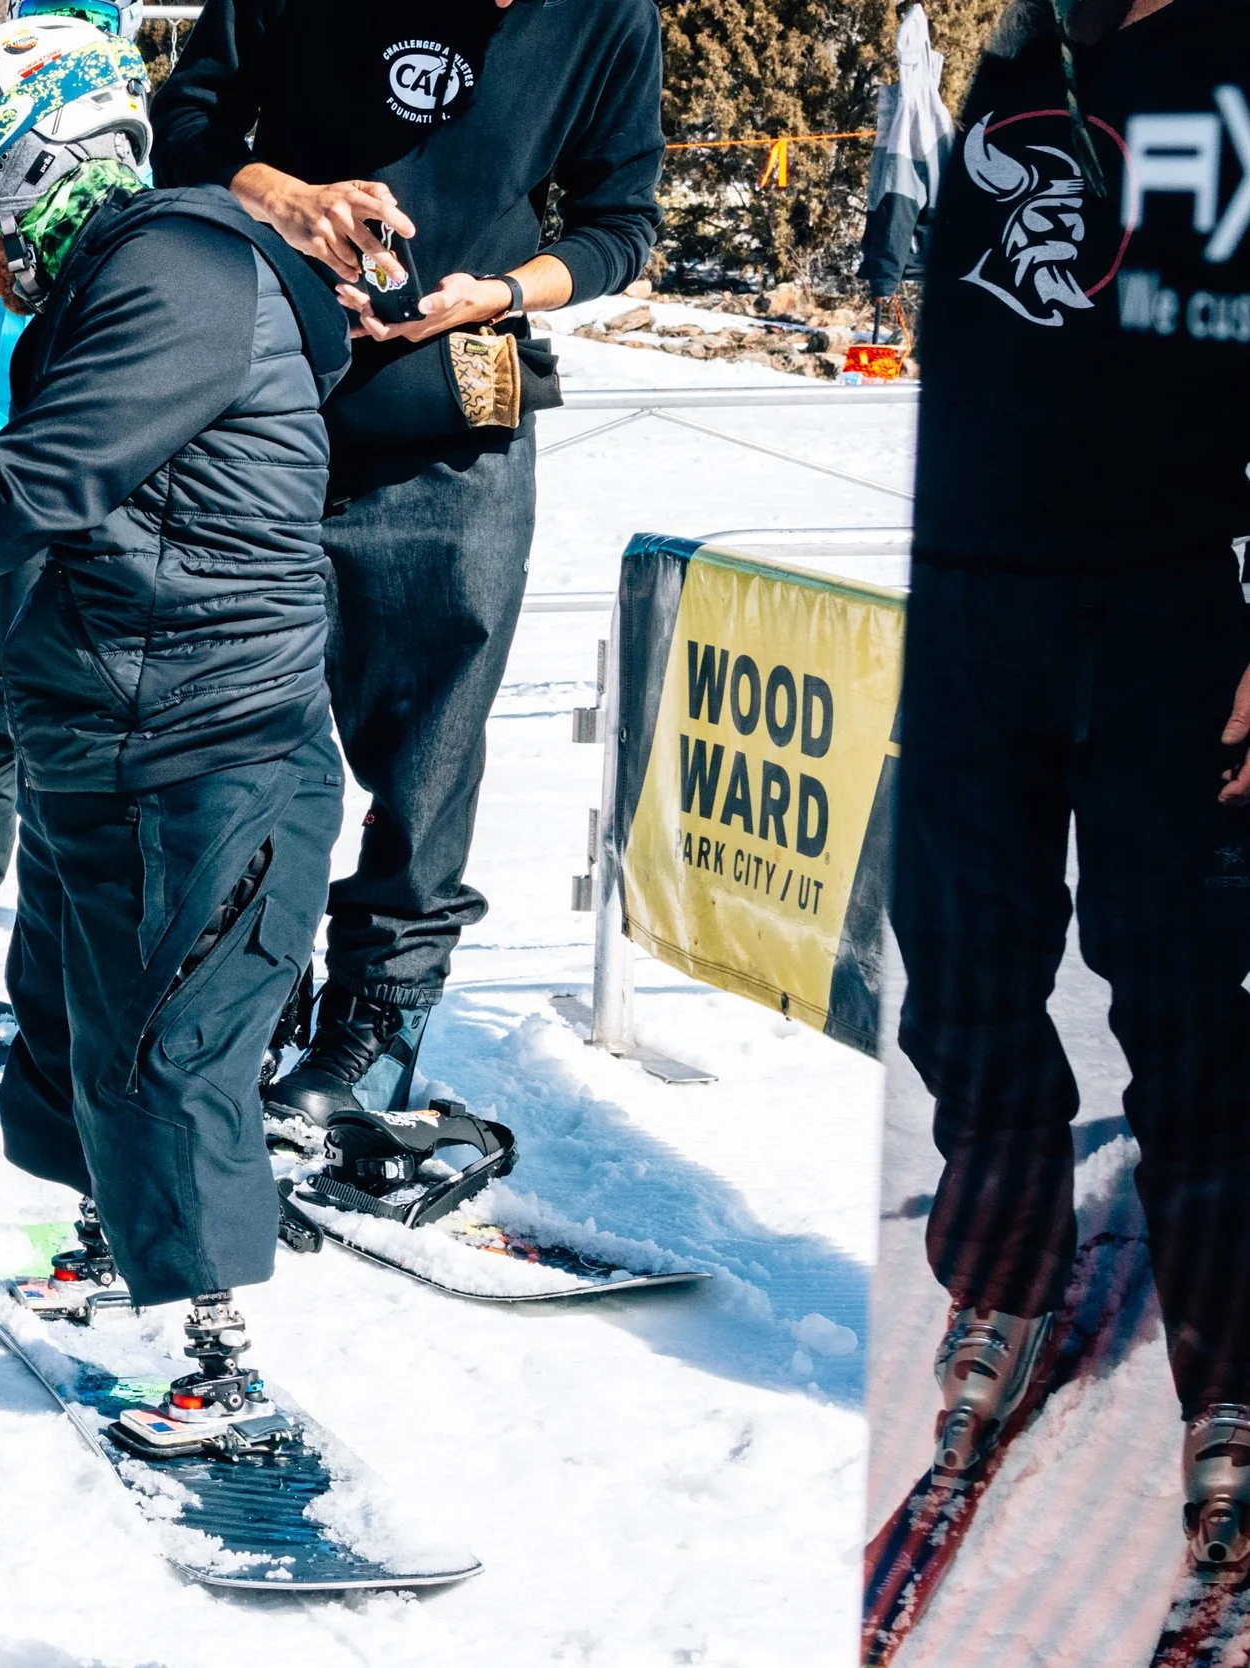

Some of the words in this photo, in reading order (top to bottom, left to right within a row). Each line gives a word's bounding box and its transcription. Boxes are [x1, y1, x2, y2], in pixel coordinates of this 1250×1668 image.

[383, 40, 441, 60] CHALLENGED
[442, 47, 474, 87] AHLETES
[387, 97, 446, 123] FOUNDATI
[687, 640, 834, 759] WOOD
[680, 734, 829, 858] WARD
[734, 849, 776, 895] CITY
[798, 874, 823, 915] UT
